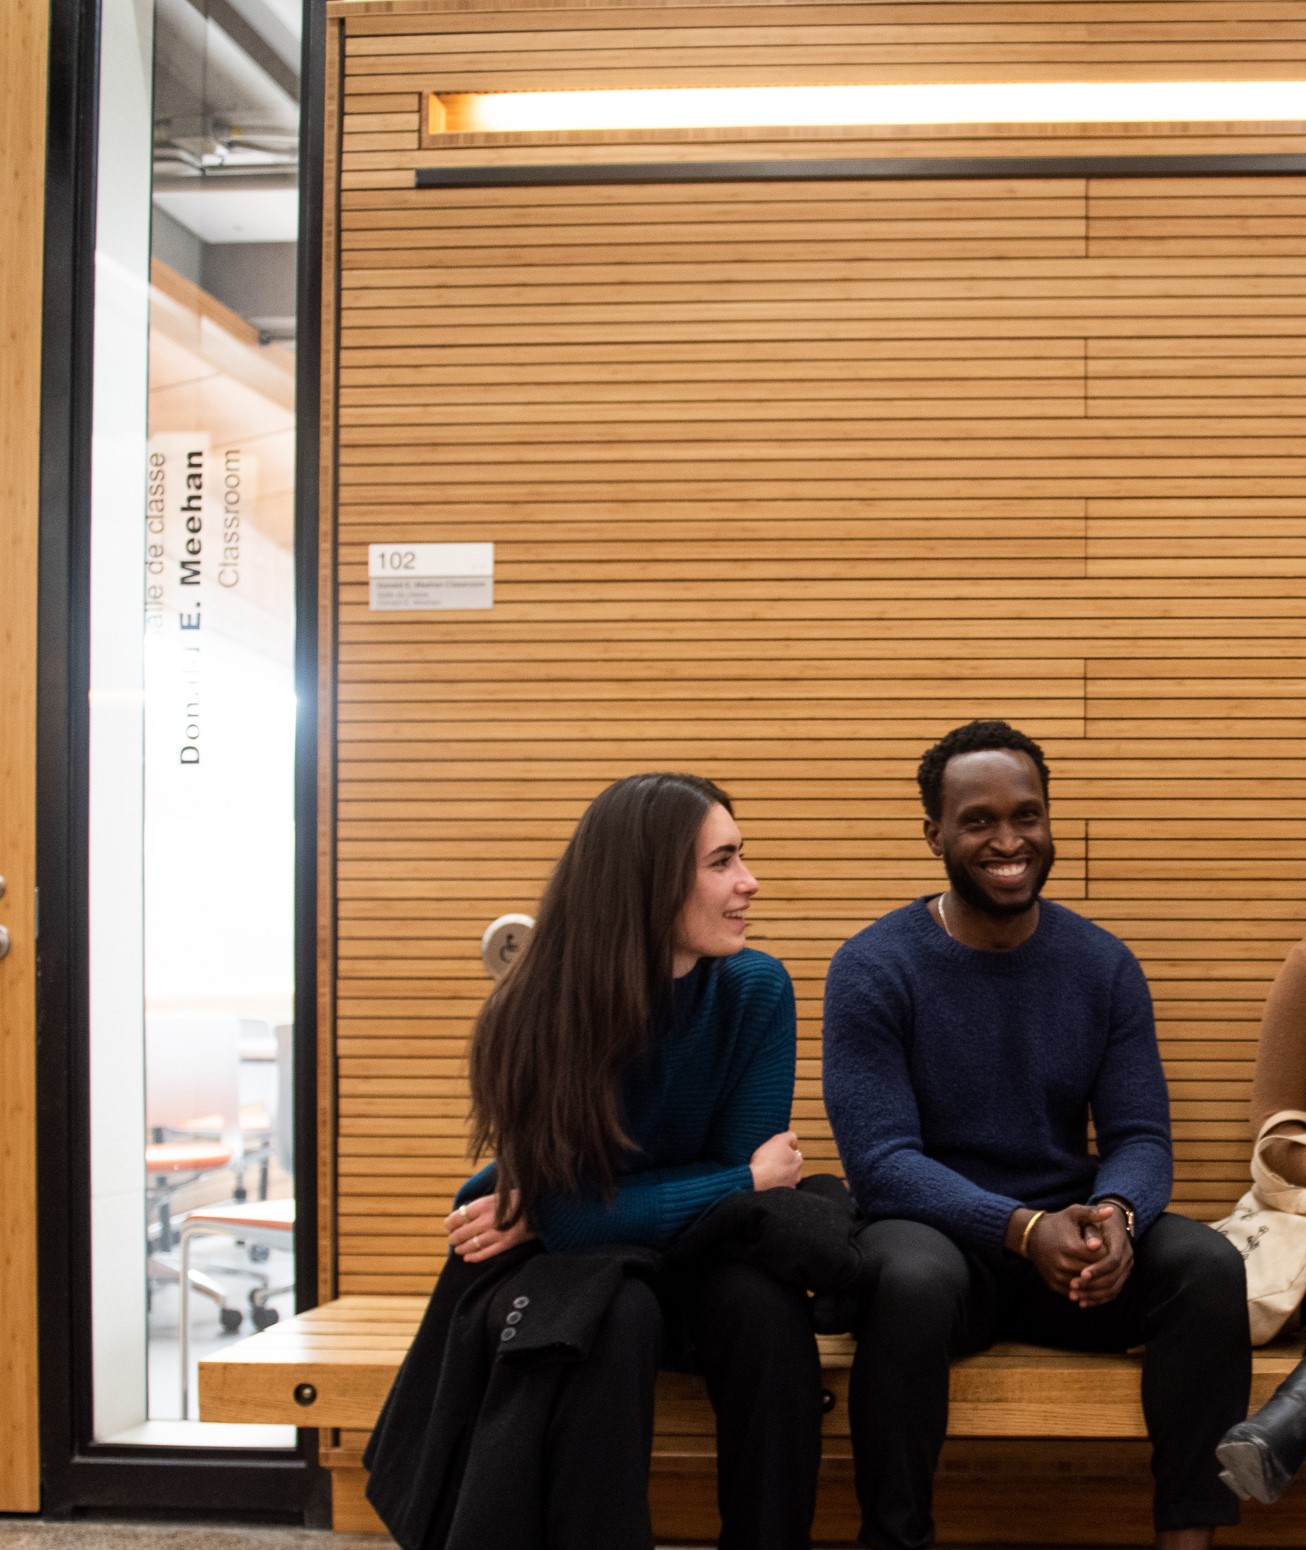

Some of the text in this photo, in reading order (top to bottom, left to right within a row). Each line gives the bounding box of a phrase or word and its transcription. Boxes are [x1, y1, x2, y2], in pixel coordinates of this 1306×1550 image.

[145, 453, 165, 533] classe
[180, 450, 203, 585] Meehan
[217, 449, 240, 588] Classroom
[145, 544, 164, 574] de
[378, 551, 415, 570] 102
[180, 602, 201, 630] E.
